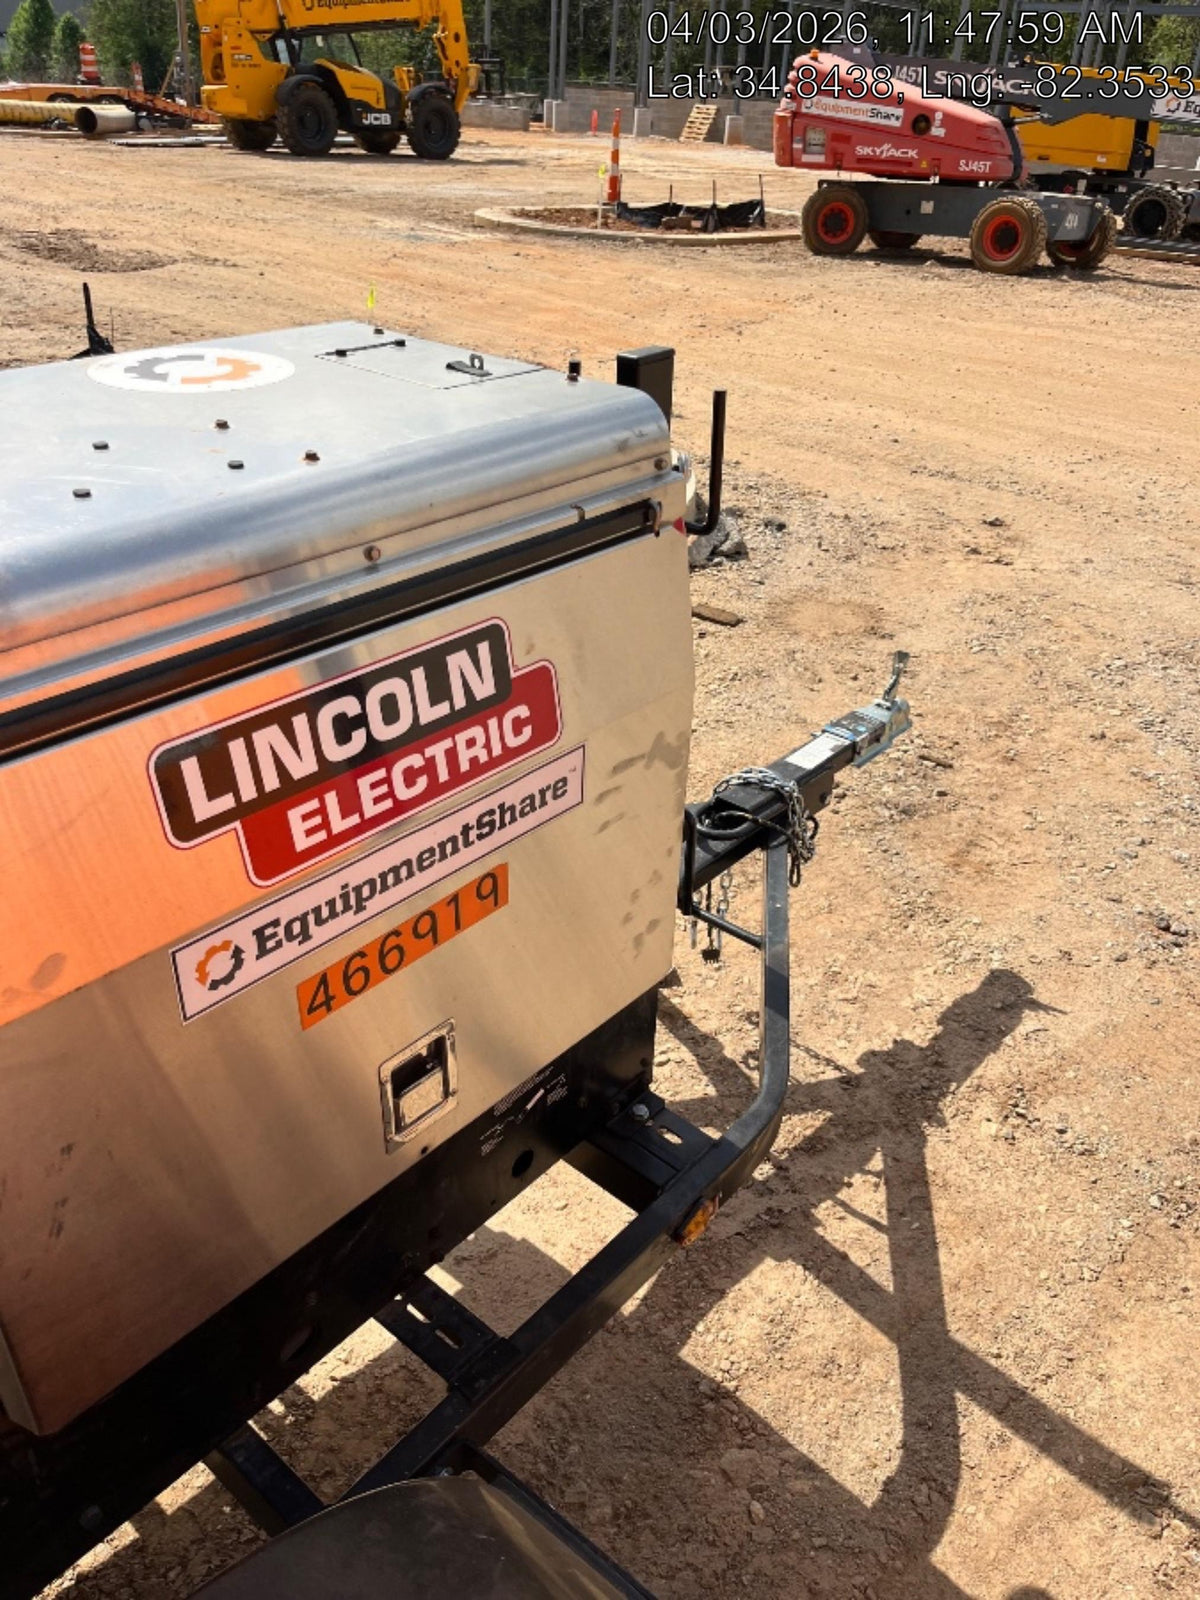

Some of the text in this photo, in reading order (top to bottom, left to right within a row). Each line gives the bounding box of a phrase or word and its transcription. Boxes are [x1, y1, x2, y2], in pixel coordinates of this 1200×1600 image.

[362, 113, 392, 126] JCB
[814, 98, 902, 121] EquipmentShare
[855, 143, 919, 159] SKYJACK
[958, 160, 992, 173] SJ45T
[180, 640, 497, 823] LINCOLN
[287, 704, 532, 853] ELECTRIC
[252, 775, 569, 961] EquipmentShare
[306, 871, 499, 1018] 466919
